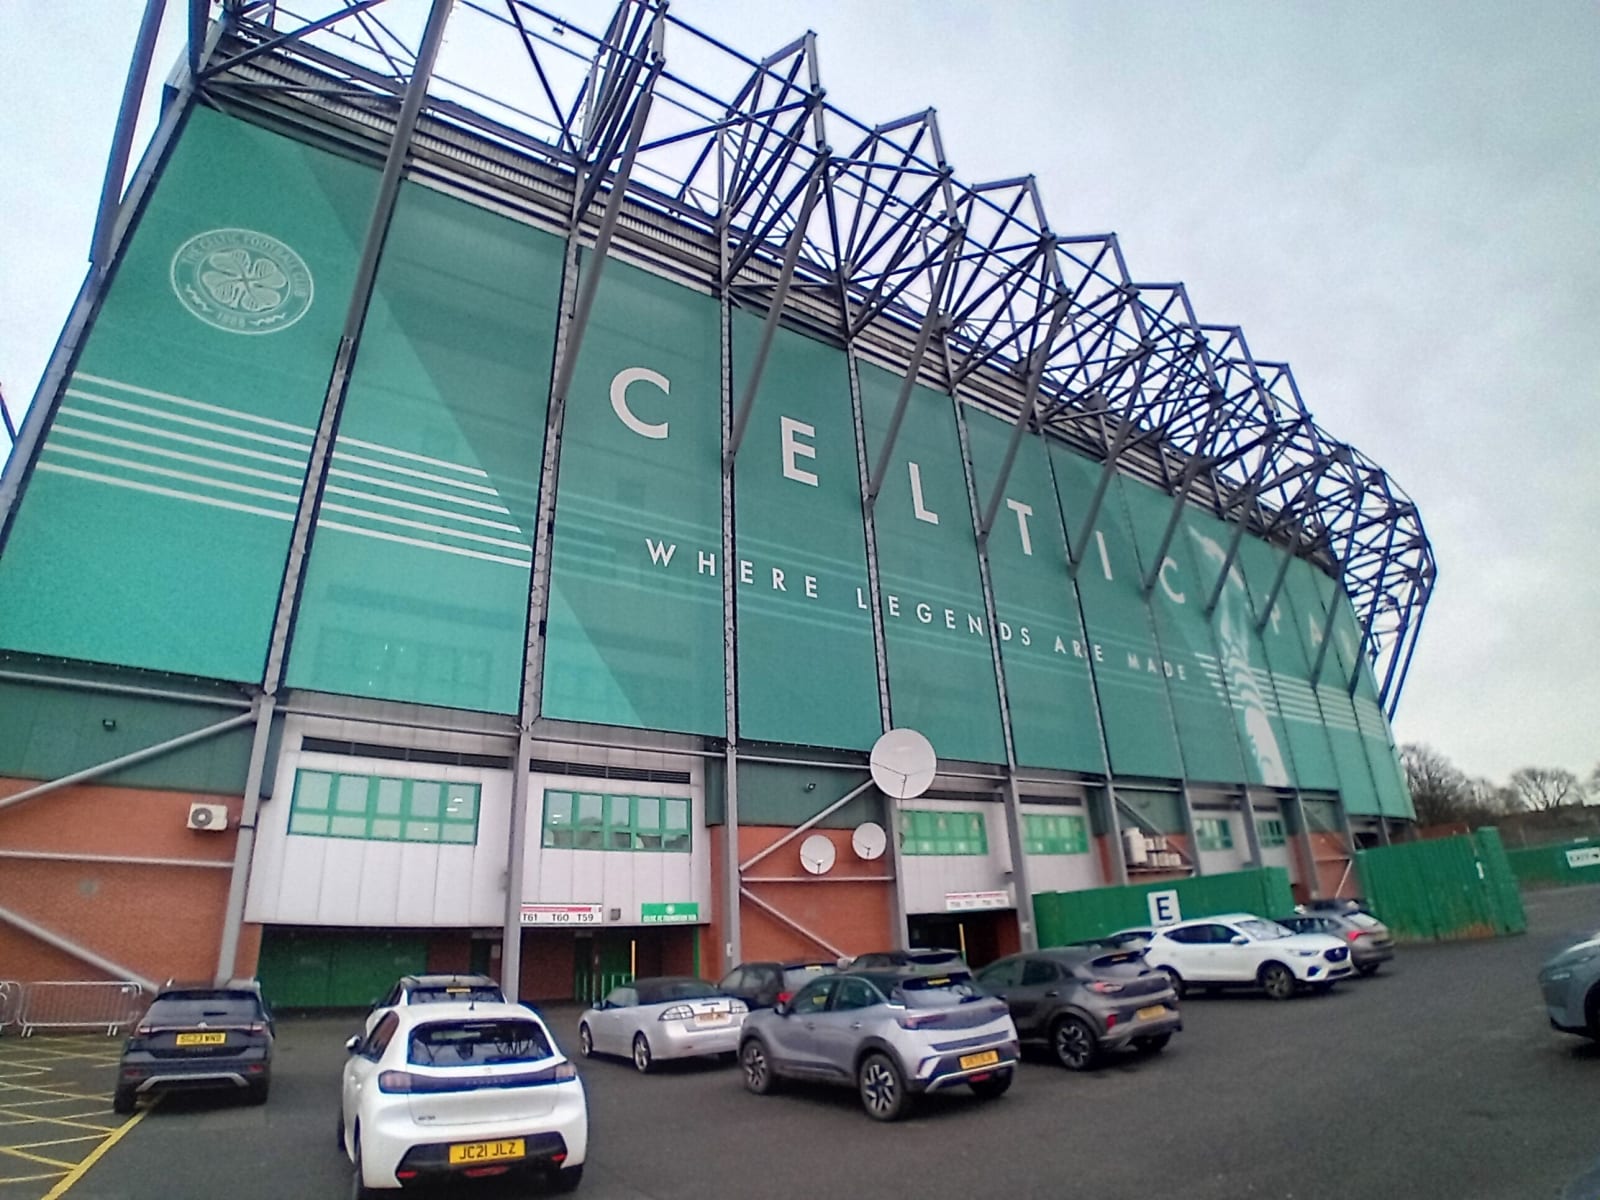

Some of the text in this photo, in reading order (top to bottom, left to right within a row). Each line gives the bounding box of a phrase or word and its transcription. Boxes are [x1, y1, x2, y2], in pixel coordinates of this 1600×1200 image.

[610, 366, 1186, 605] CELTIC
[645, 537, 1186, 681] WHERE LEGENDS ARE MADE
[522, 913, 594, 922] T61 T60 T59
[1155, 896, 1174, 921] E
[459, 1141, 516, 1160] JC21 JLZ
